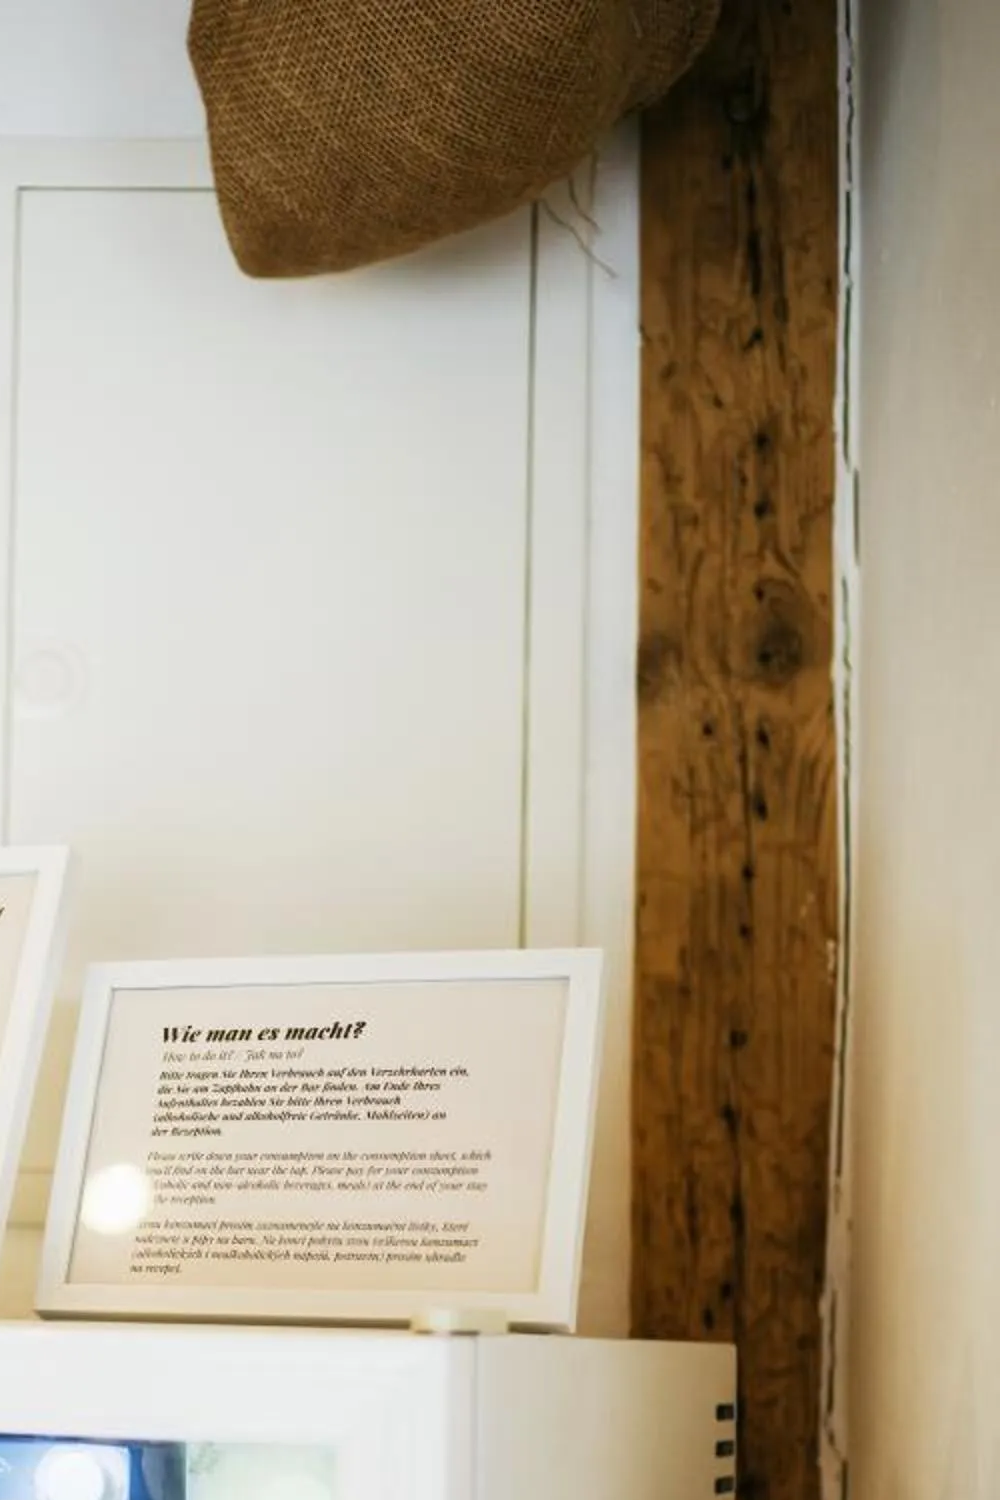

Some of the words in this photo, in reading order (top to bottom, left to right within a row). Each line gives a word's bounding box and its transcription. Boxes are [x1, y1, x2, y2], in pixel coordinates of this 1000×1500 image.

[163, 1025, 202, 1043] Wie
[206, 1028, 253, 1043] man
[257, 1026, 280, 1042] es
[284, 1021, 367, 1041] macht?
